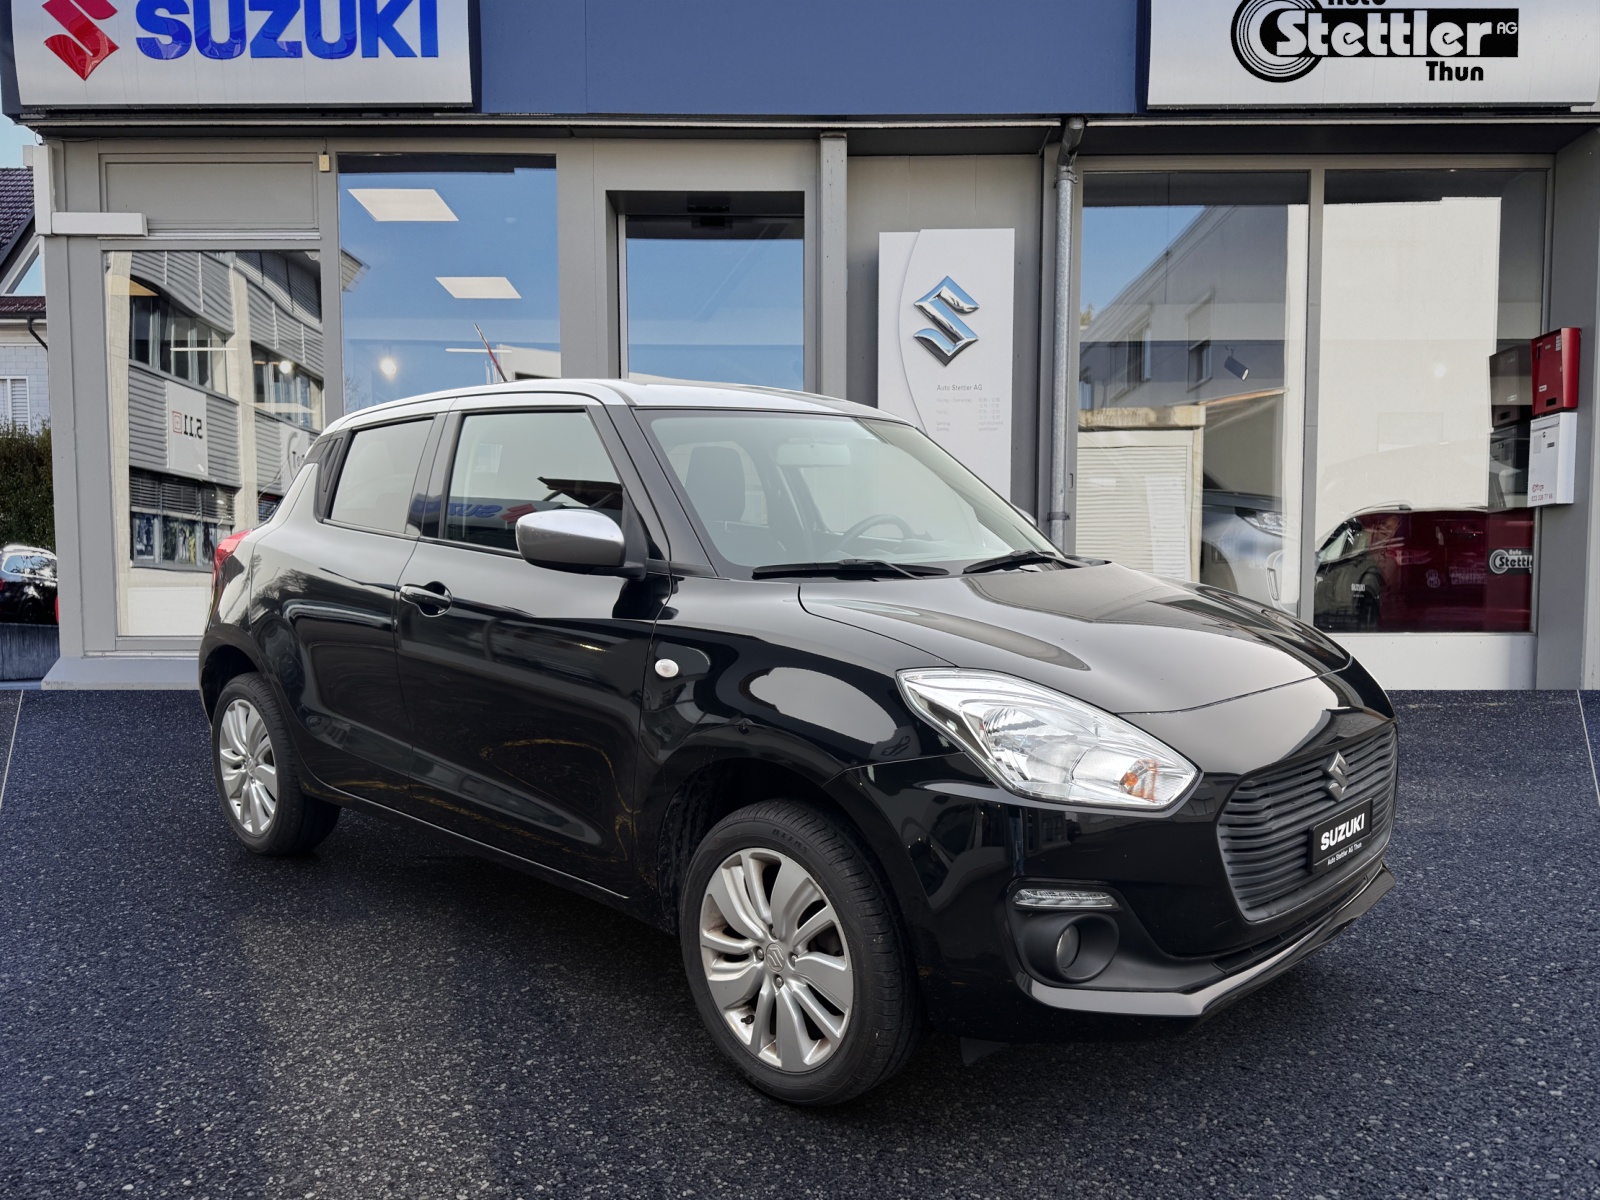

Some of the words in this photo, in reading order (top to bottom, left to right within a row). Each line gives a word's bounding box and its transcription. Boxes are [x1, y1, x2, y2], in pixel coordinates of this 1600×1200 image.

[136, 0, 439, 59] SUZUKI
[1276, 9, 1492, 57] Stettler
[1496, 21, 1518, 35] AG
[1426, 60, 1484, 82] Thun
[1321, 813, 1365, 850] SUZUKI
